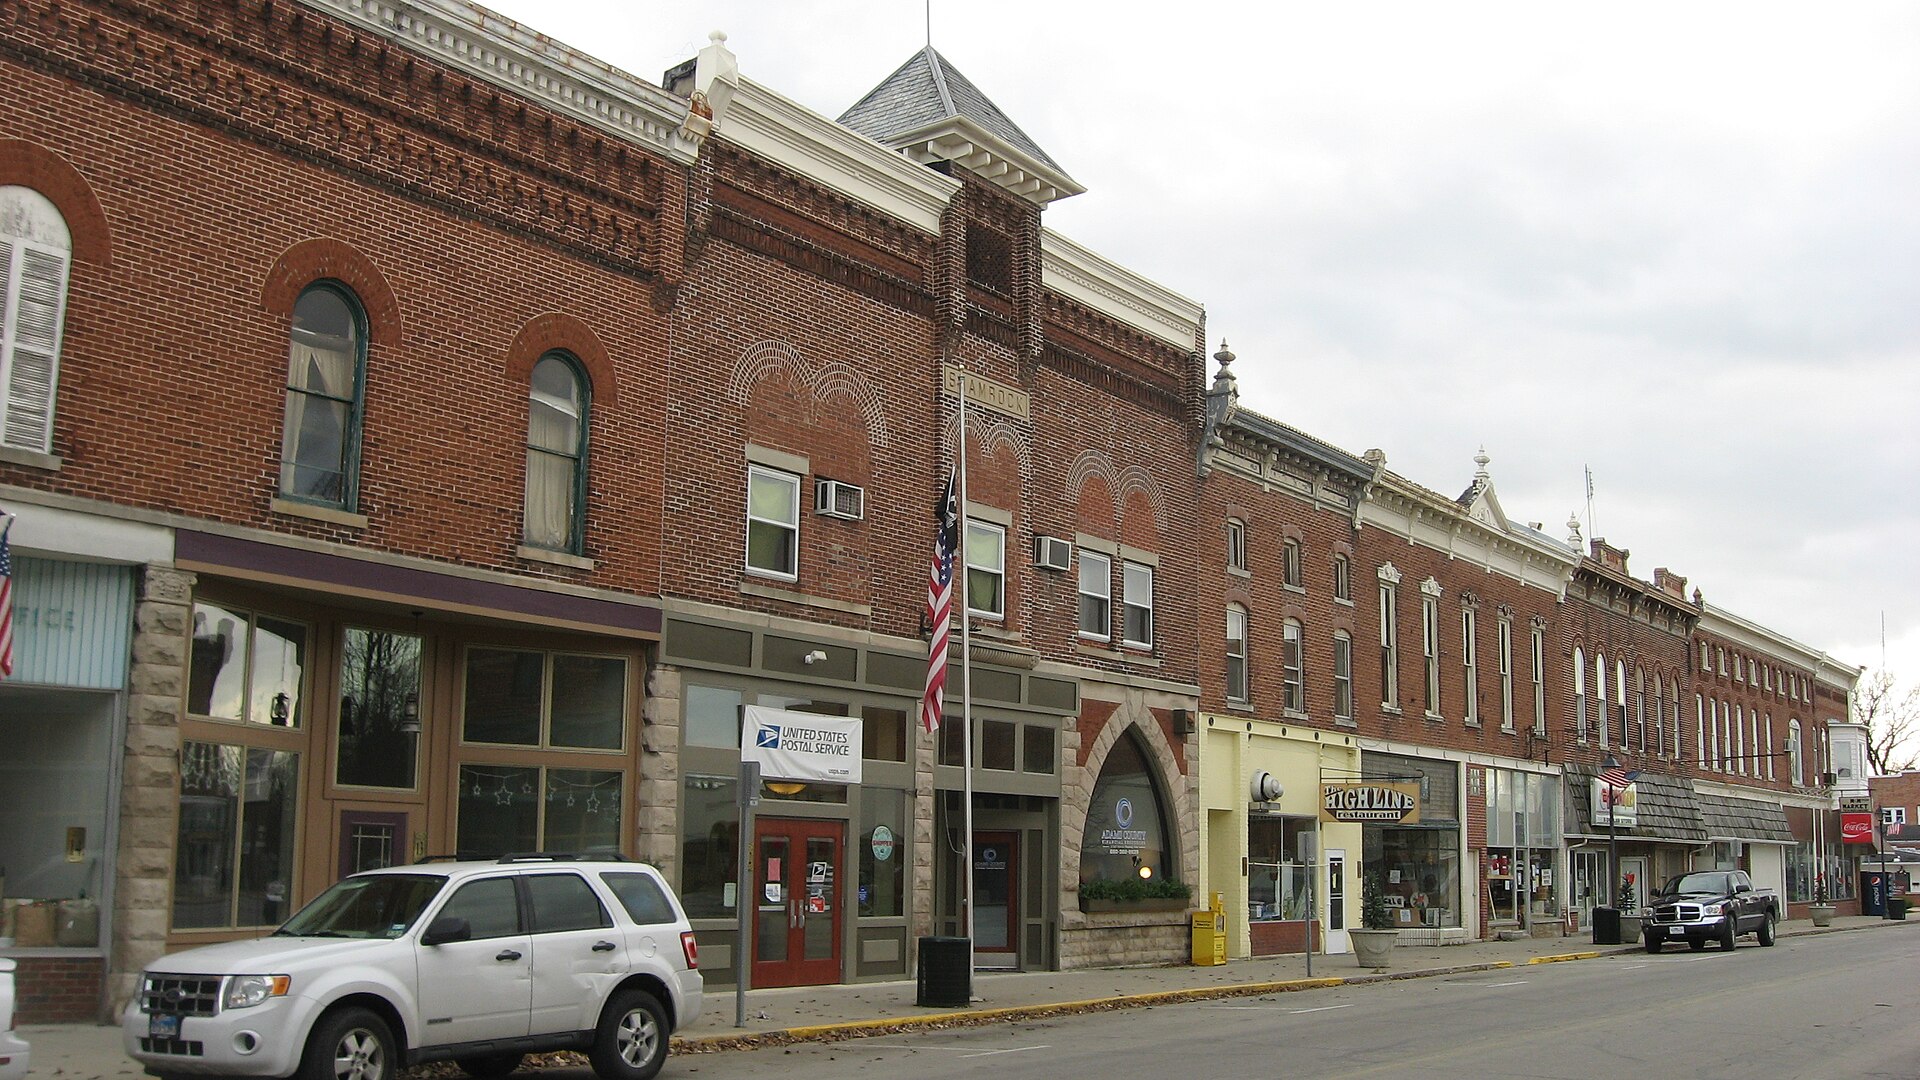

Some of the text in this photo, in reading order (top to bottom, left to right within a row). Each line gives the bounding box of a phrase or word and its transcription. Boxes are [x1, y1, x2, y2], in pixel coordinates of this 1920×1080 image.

[949, 372, 1023, 412] SAMROCK
[16, 606, 74, 628] FICE
[783, 727, 848, 743] UNITED STATES
[781, 740, 849, 755] POSTAL SERVICE
[1325, 785, 1343, 795] The
[1338, 810, 1399, 818] restaurant
